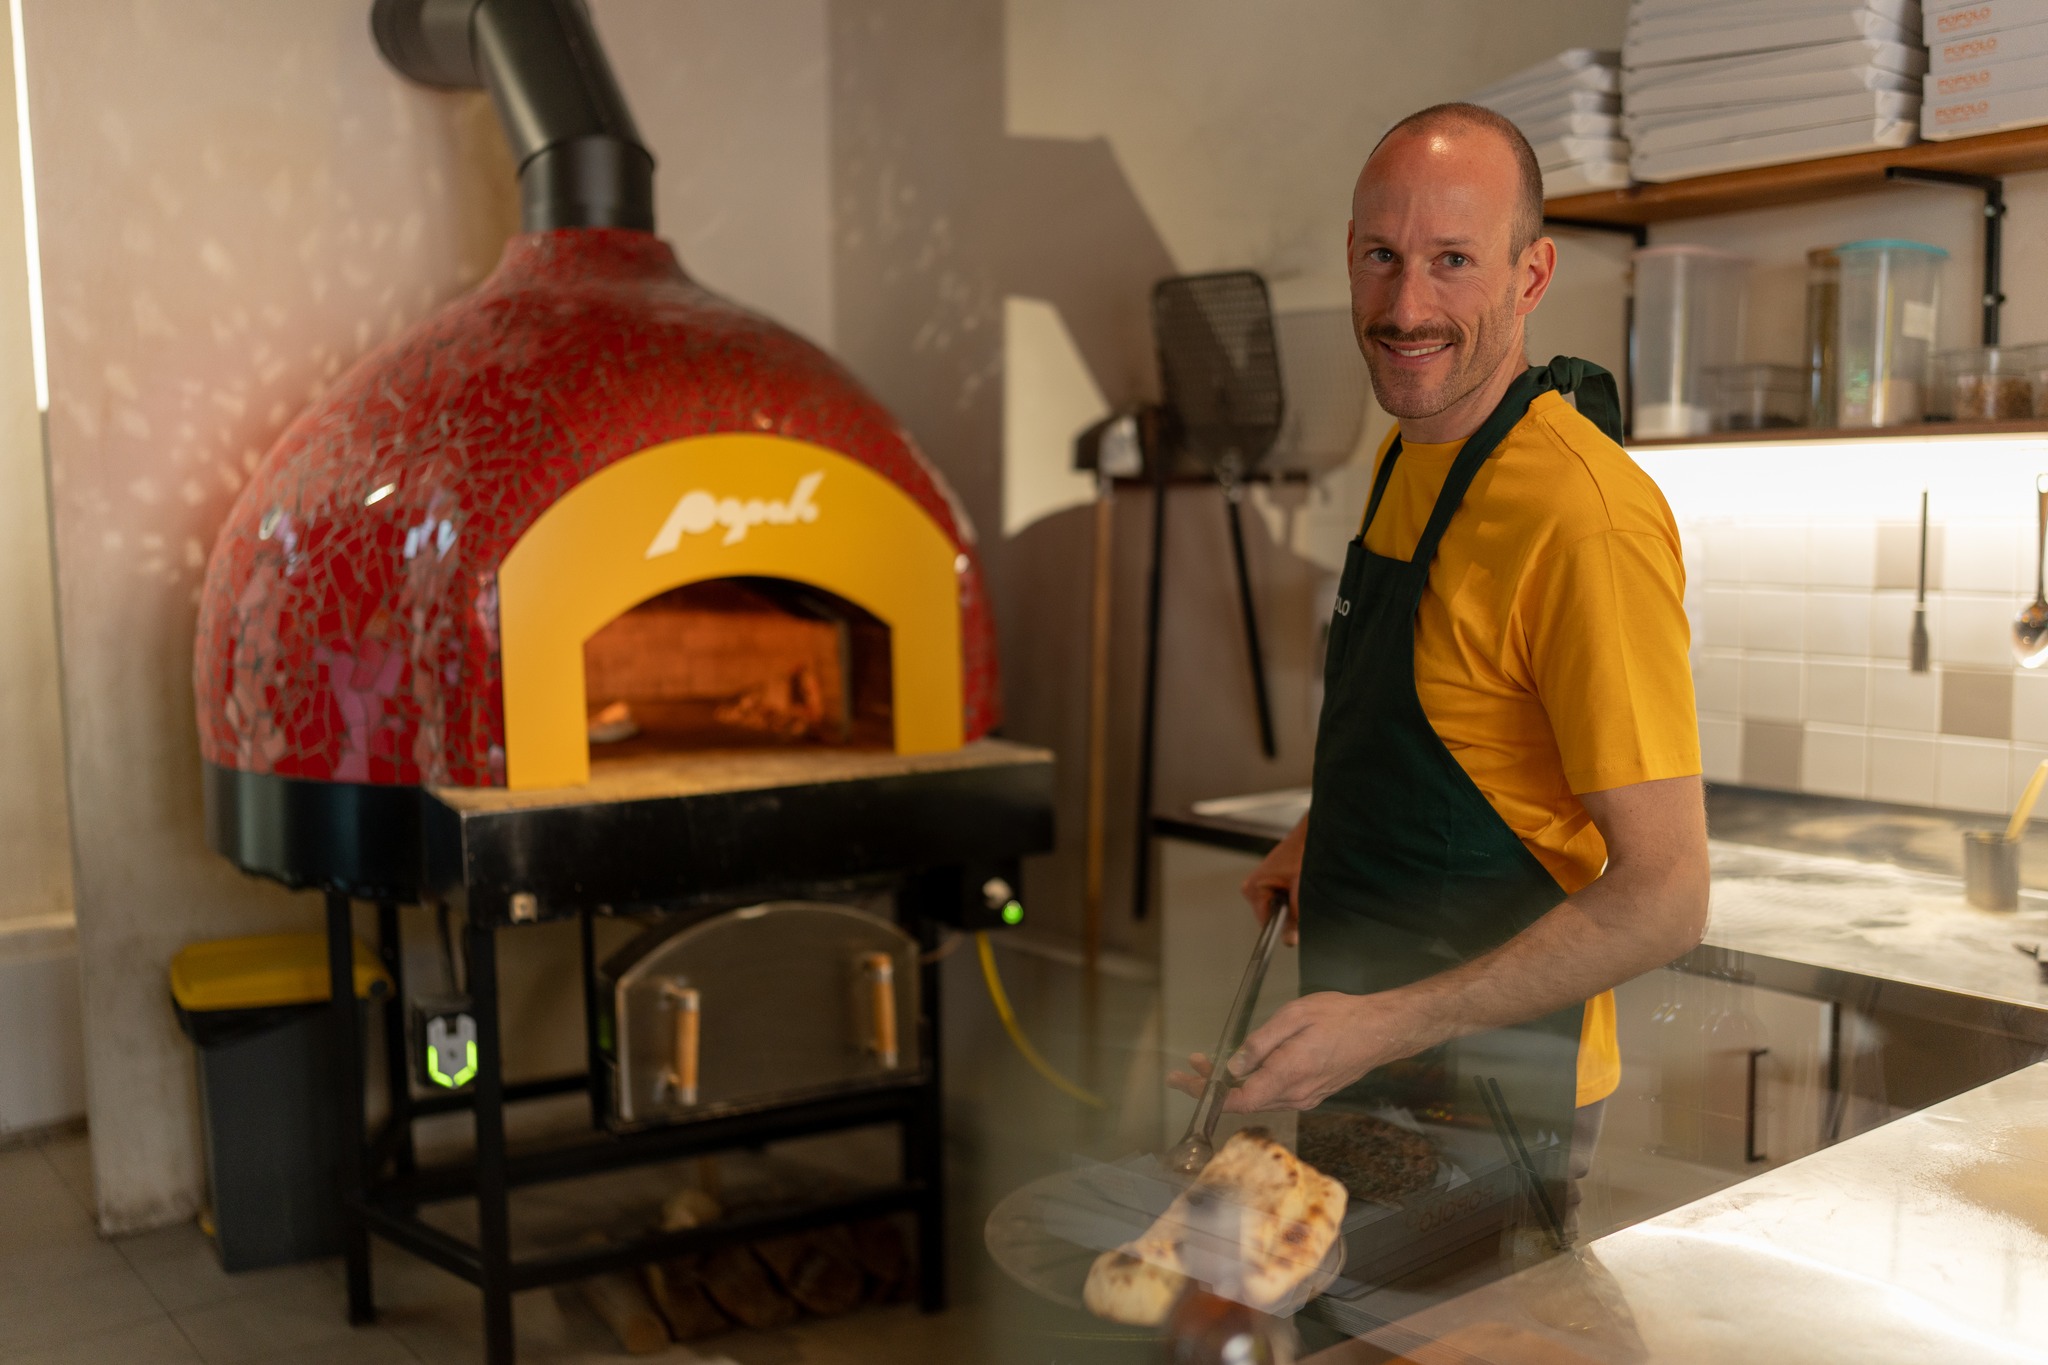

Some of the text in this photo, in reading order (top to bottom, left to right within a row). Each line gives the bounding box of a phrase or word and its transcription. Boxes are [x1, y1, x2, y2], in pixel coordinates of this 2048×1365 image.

[1937, 7, 1991, 25] POPOLO
[1944, 37, 1996, 56] POPOLO
[1937, 69, 1990, 87] POPOLO
[1935, 100, 1988, 116] POPOLO
